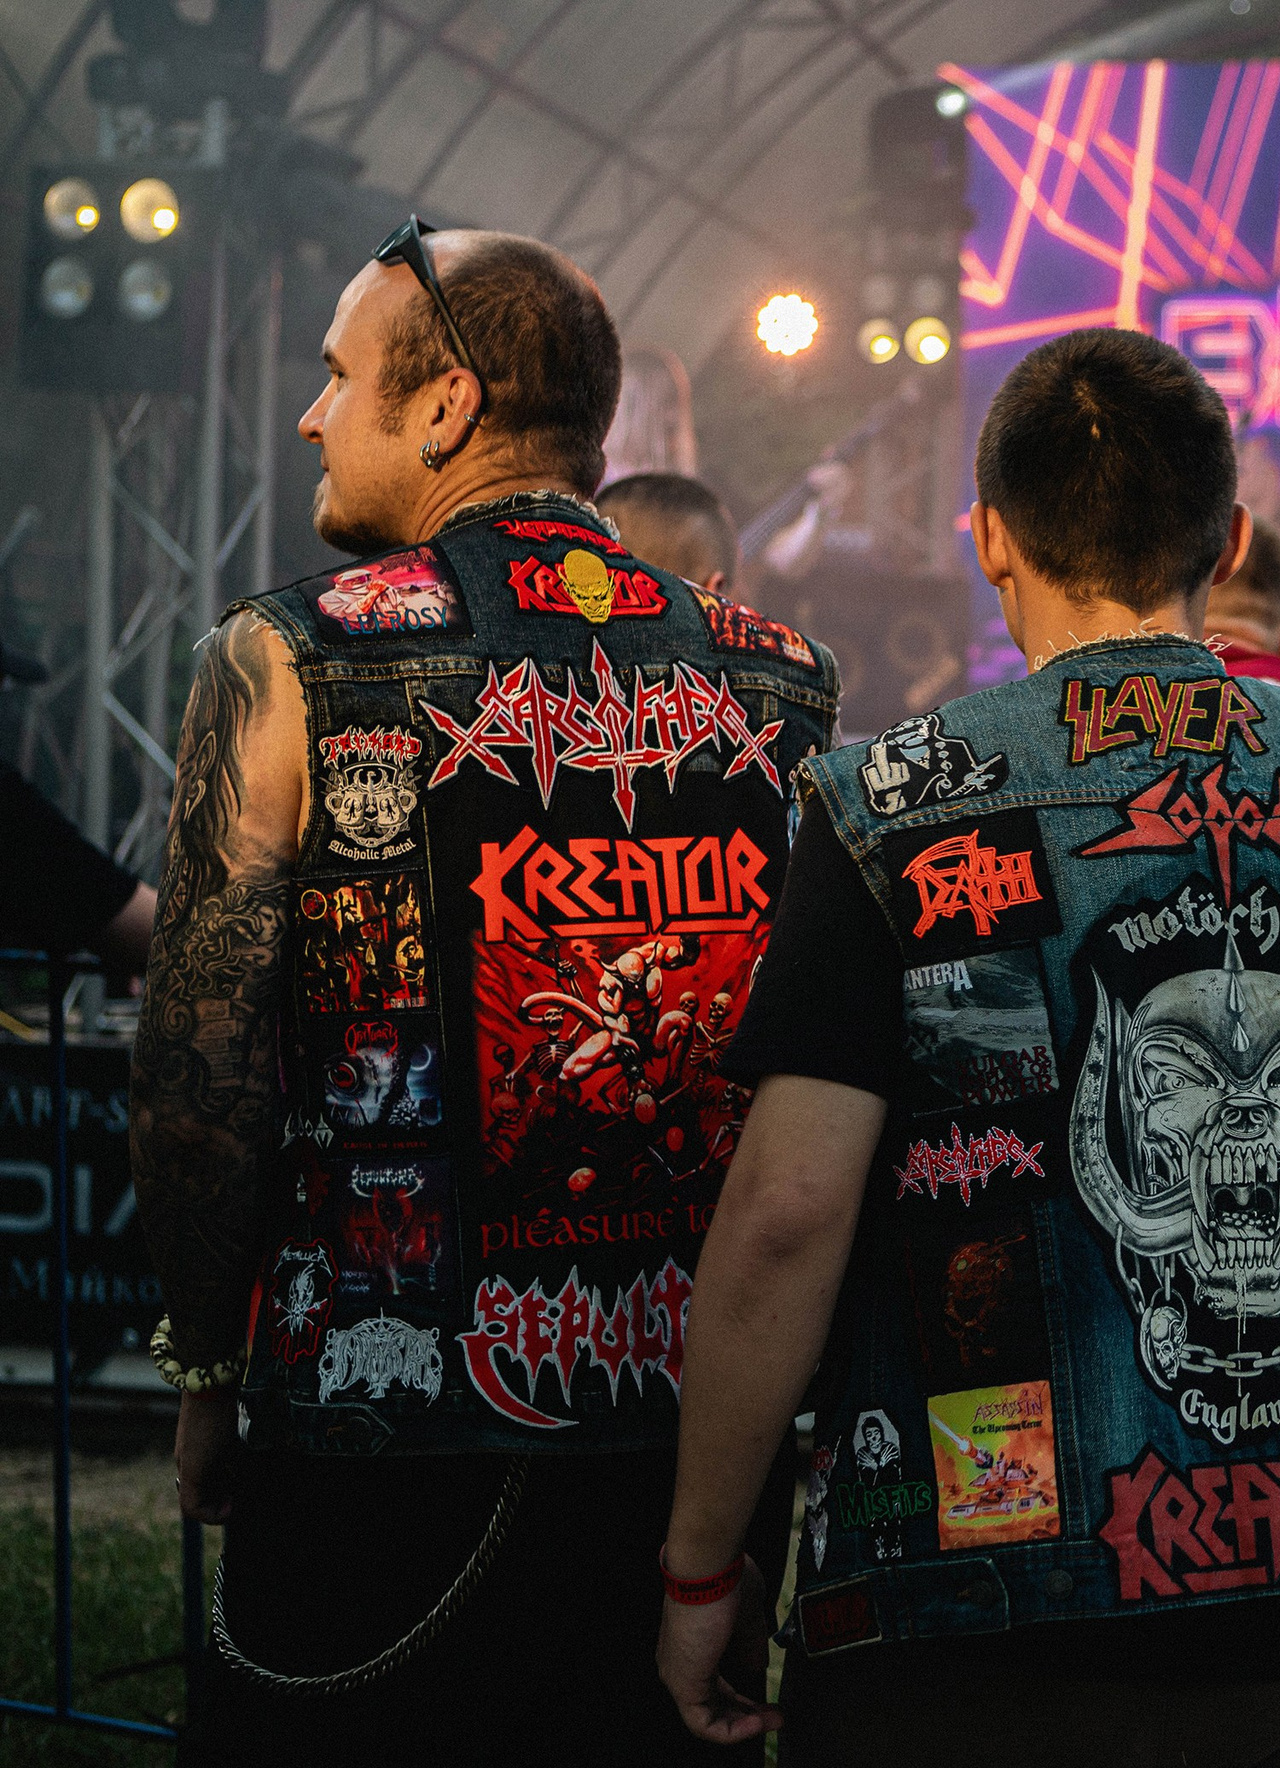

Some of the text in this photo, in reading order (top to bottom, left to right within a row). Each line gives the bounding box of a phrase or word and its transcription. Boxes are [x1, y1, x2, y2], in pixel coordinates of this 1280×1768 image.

[507, 555, 668, 616] KROR
[319, 725, 422, 770] TANKARD
[1065, 677, 1264, 762] SLAYER
[328, 837, 417, 861] Alcoholic Metal
[469, 825, 771, 942] KREATOR
[902, 829, 1043, 938] DEATH
[903, 959, 973, 992] ANTERA
[455, 1253, 694, 1430] SEPULT
